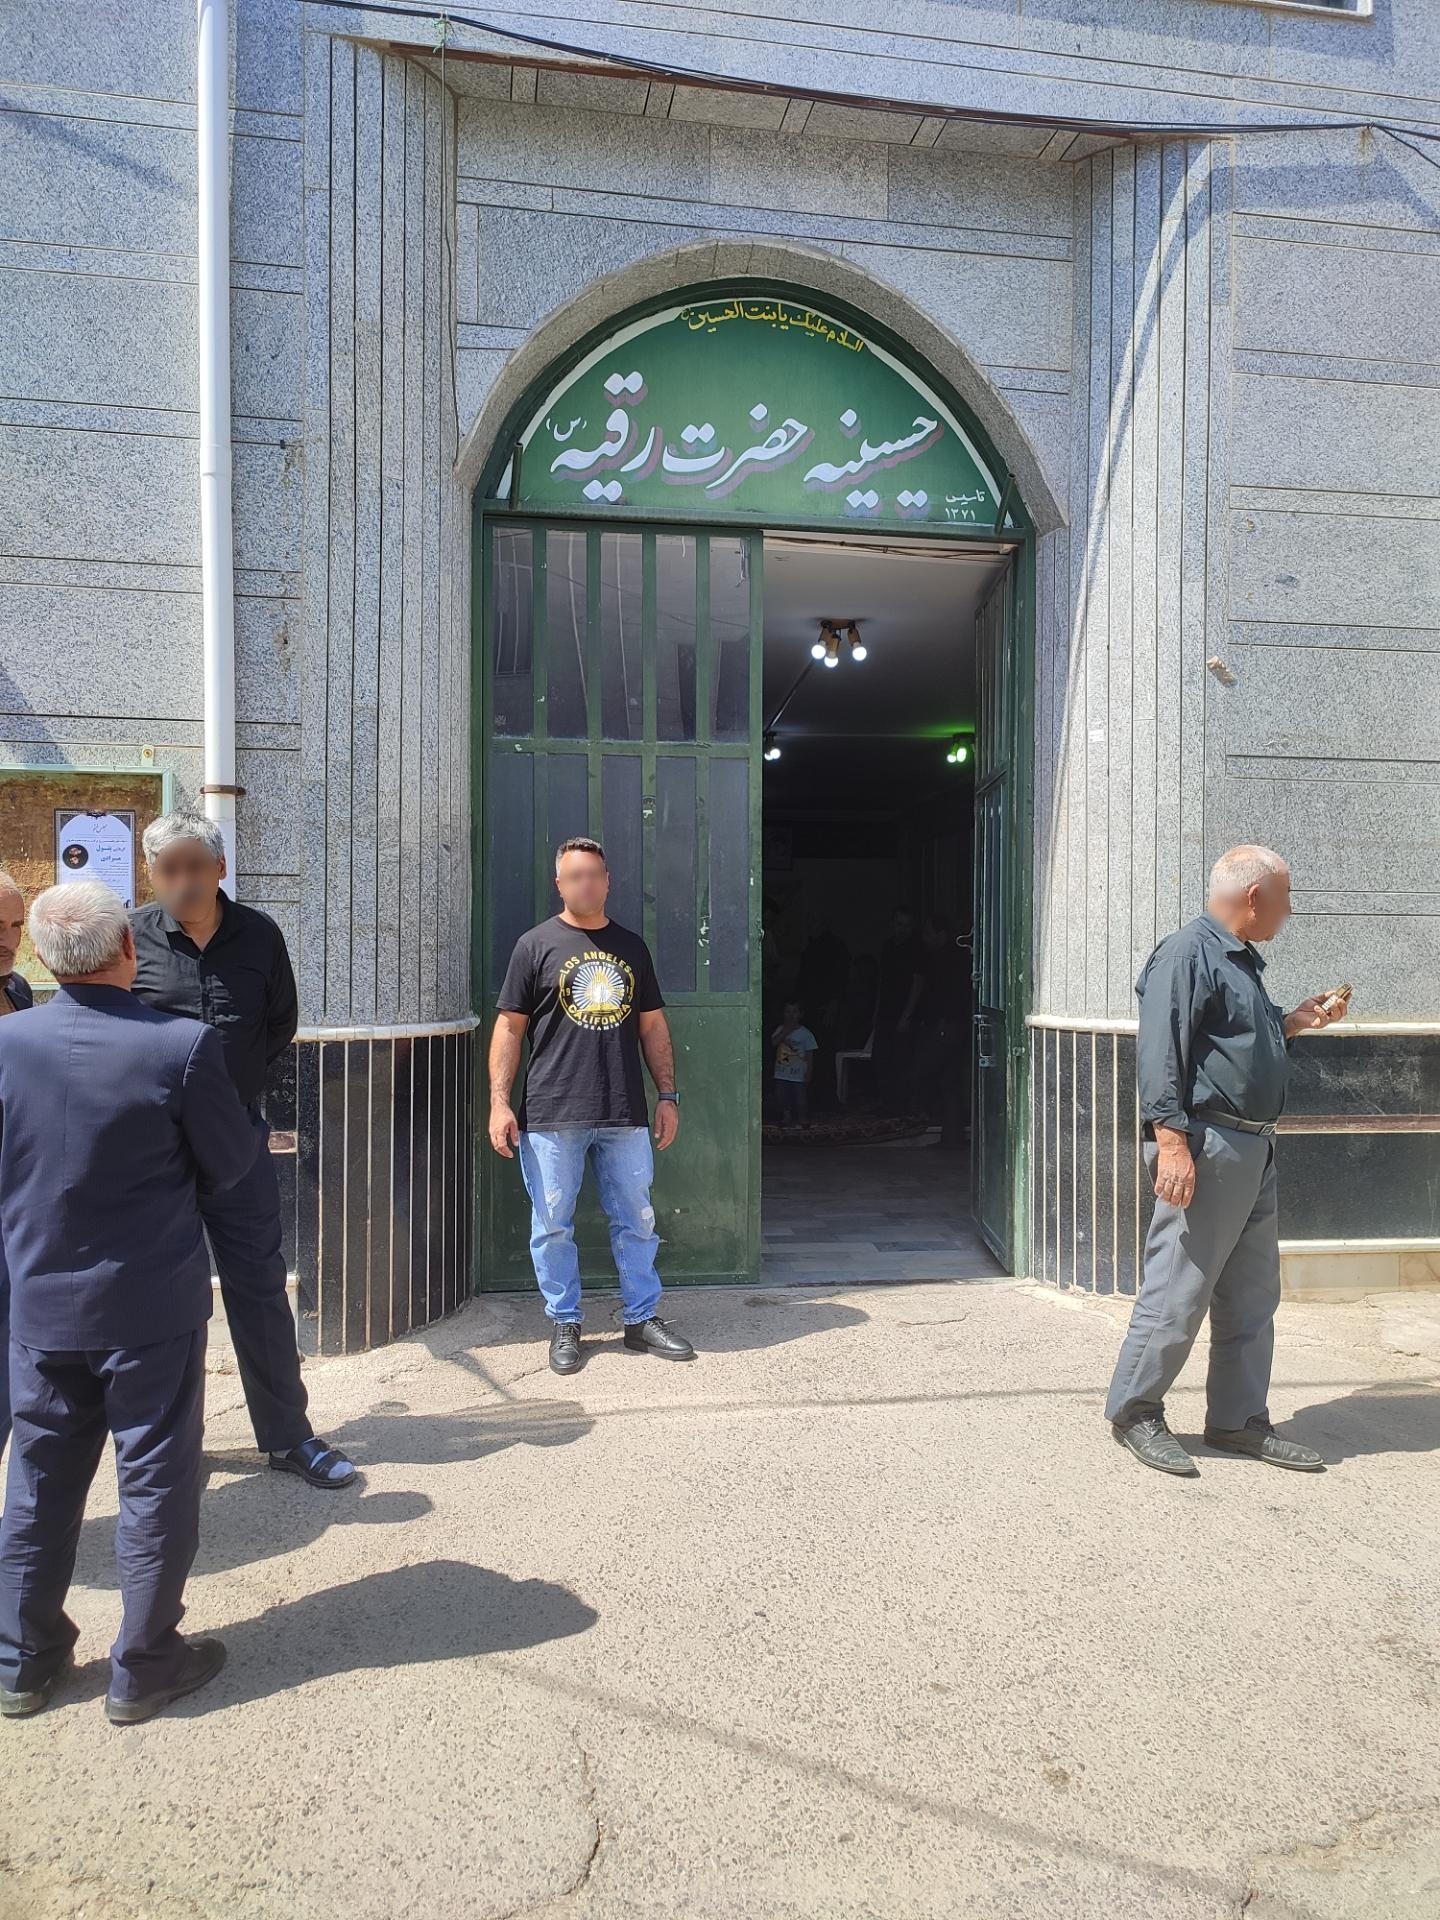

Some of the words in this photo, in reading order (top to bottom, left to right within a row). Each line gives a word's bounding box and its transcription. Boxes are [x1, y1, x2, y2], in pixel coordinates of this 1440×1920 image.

[688, 300, 745, 333] الحسین
[826, 329, 865, 353] السلام
[549, 370, 658, 503] رقیه
[663, 402, 808, 491] حضرت
[803, 408, 939, 509] حسینیه
[560, 956, 580, 975] LOS
[583, 951, 632, 973] ANGELES
[567, 1003, 631, 1026] CALIFORNIA
